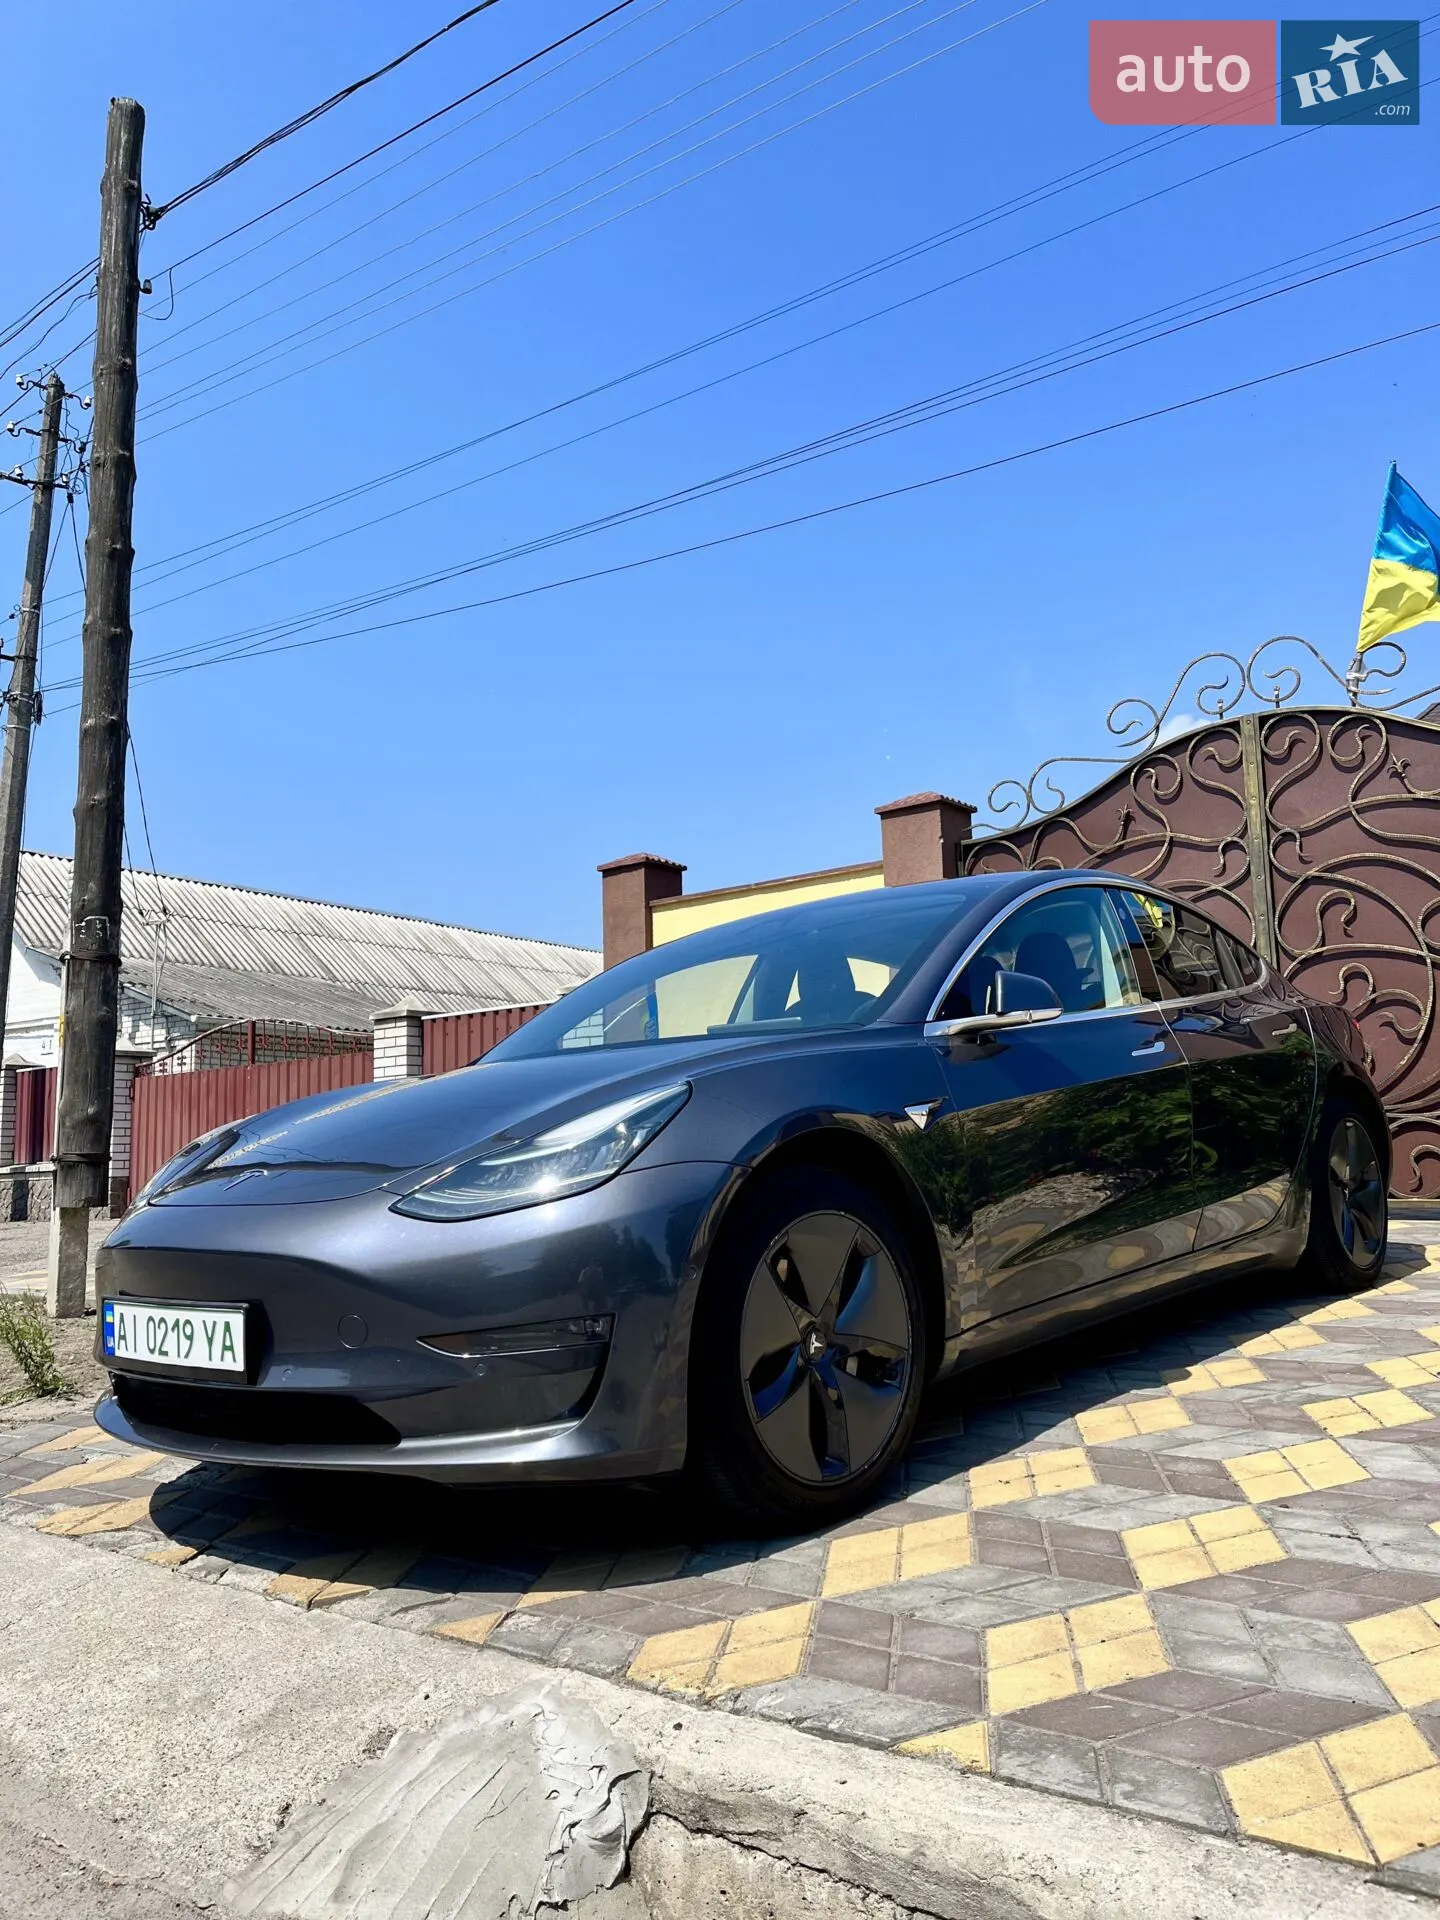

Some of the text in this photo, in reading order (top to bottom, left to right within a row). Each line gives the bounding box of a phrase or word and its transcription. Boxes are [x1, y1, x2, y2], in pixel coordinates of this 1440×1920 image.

[117, 1312, 236, 1363] AI 0219 YA
